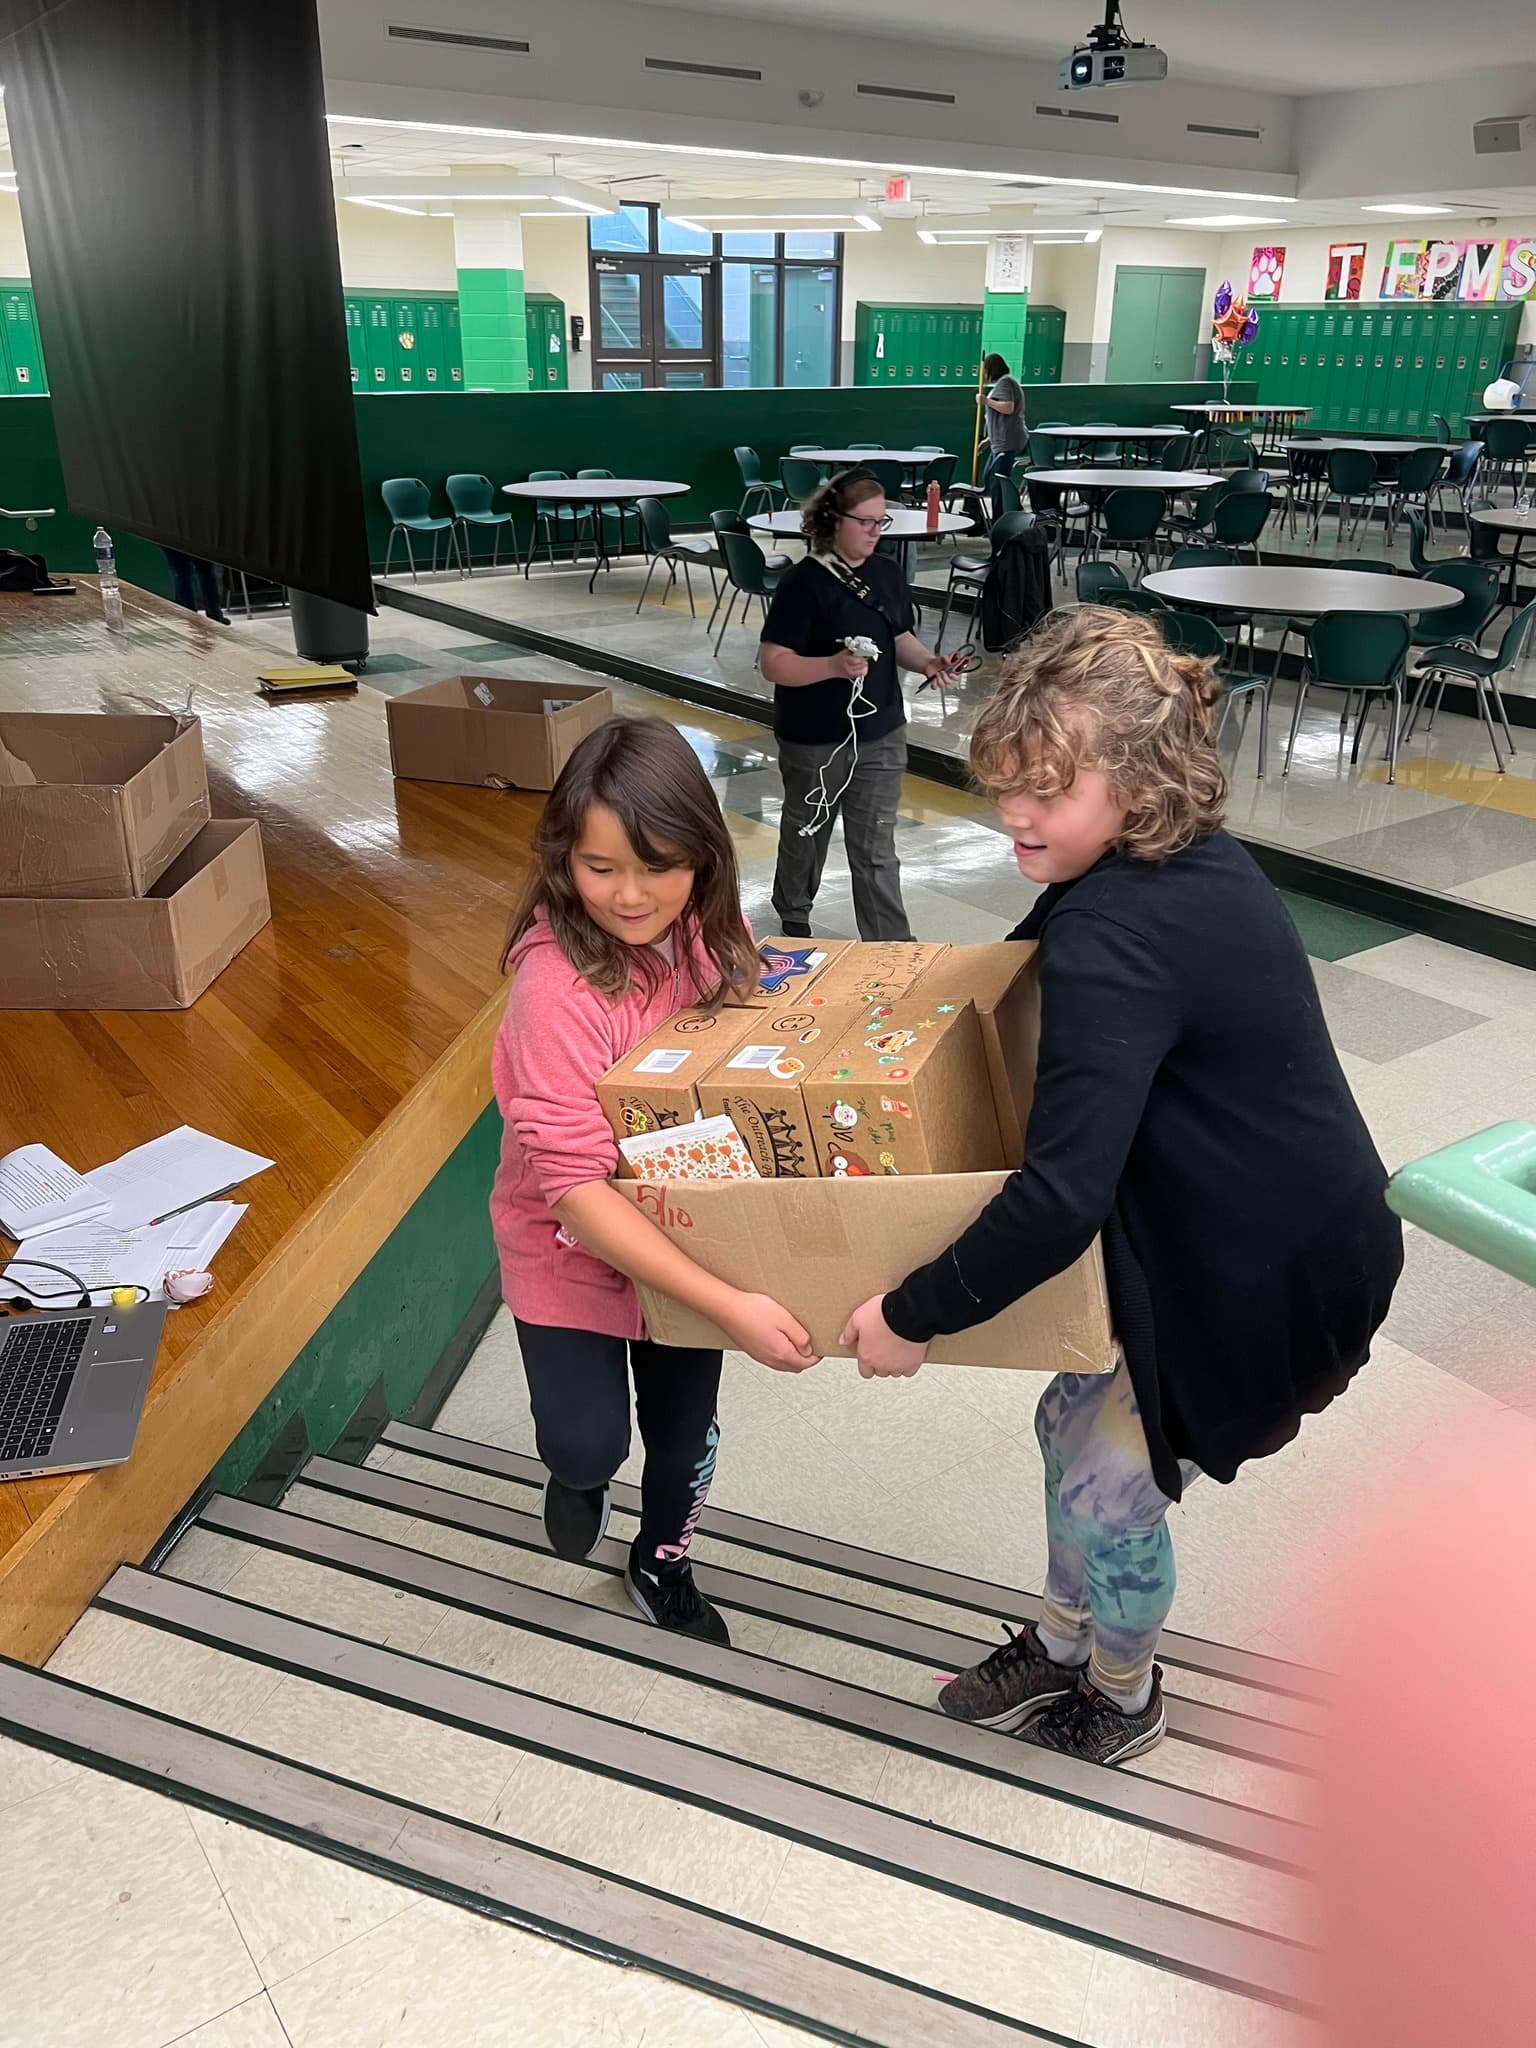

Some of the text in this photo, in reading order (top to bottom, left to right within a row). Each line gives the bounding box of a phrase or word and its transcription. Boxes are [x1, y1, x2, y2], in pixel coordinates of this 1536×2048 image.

[734, 1095, 752, 1115] The
[747, 1115, 773, 1163] Outreach
[636, 1184, 694, 1228] 5/10
